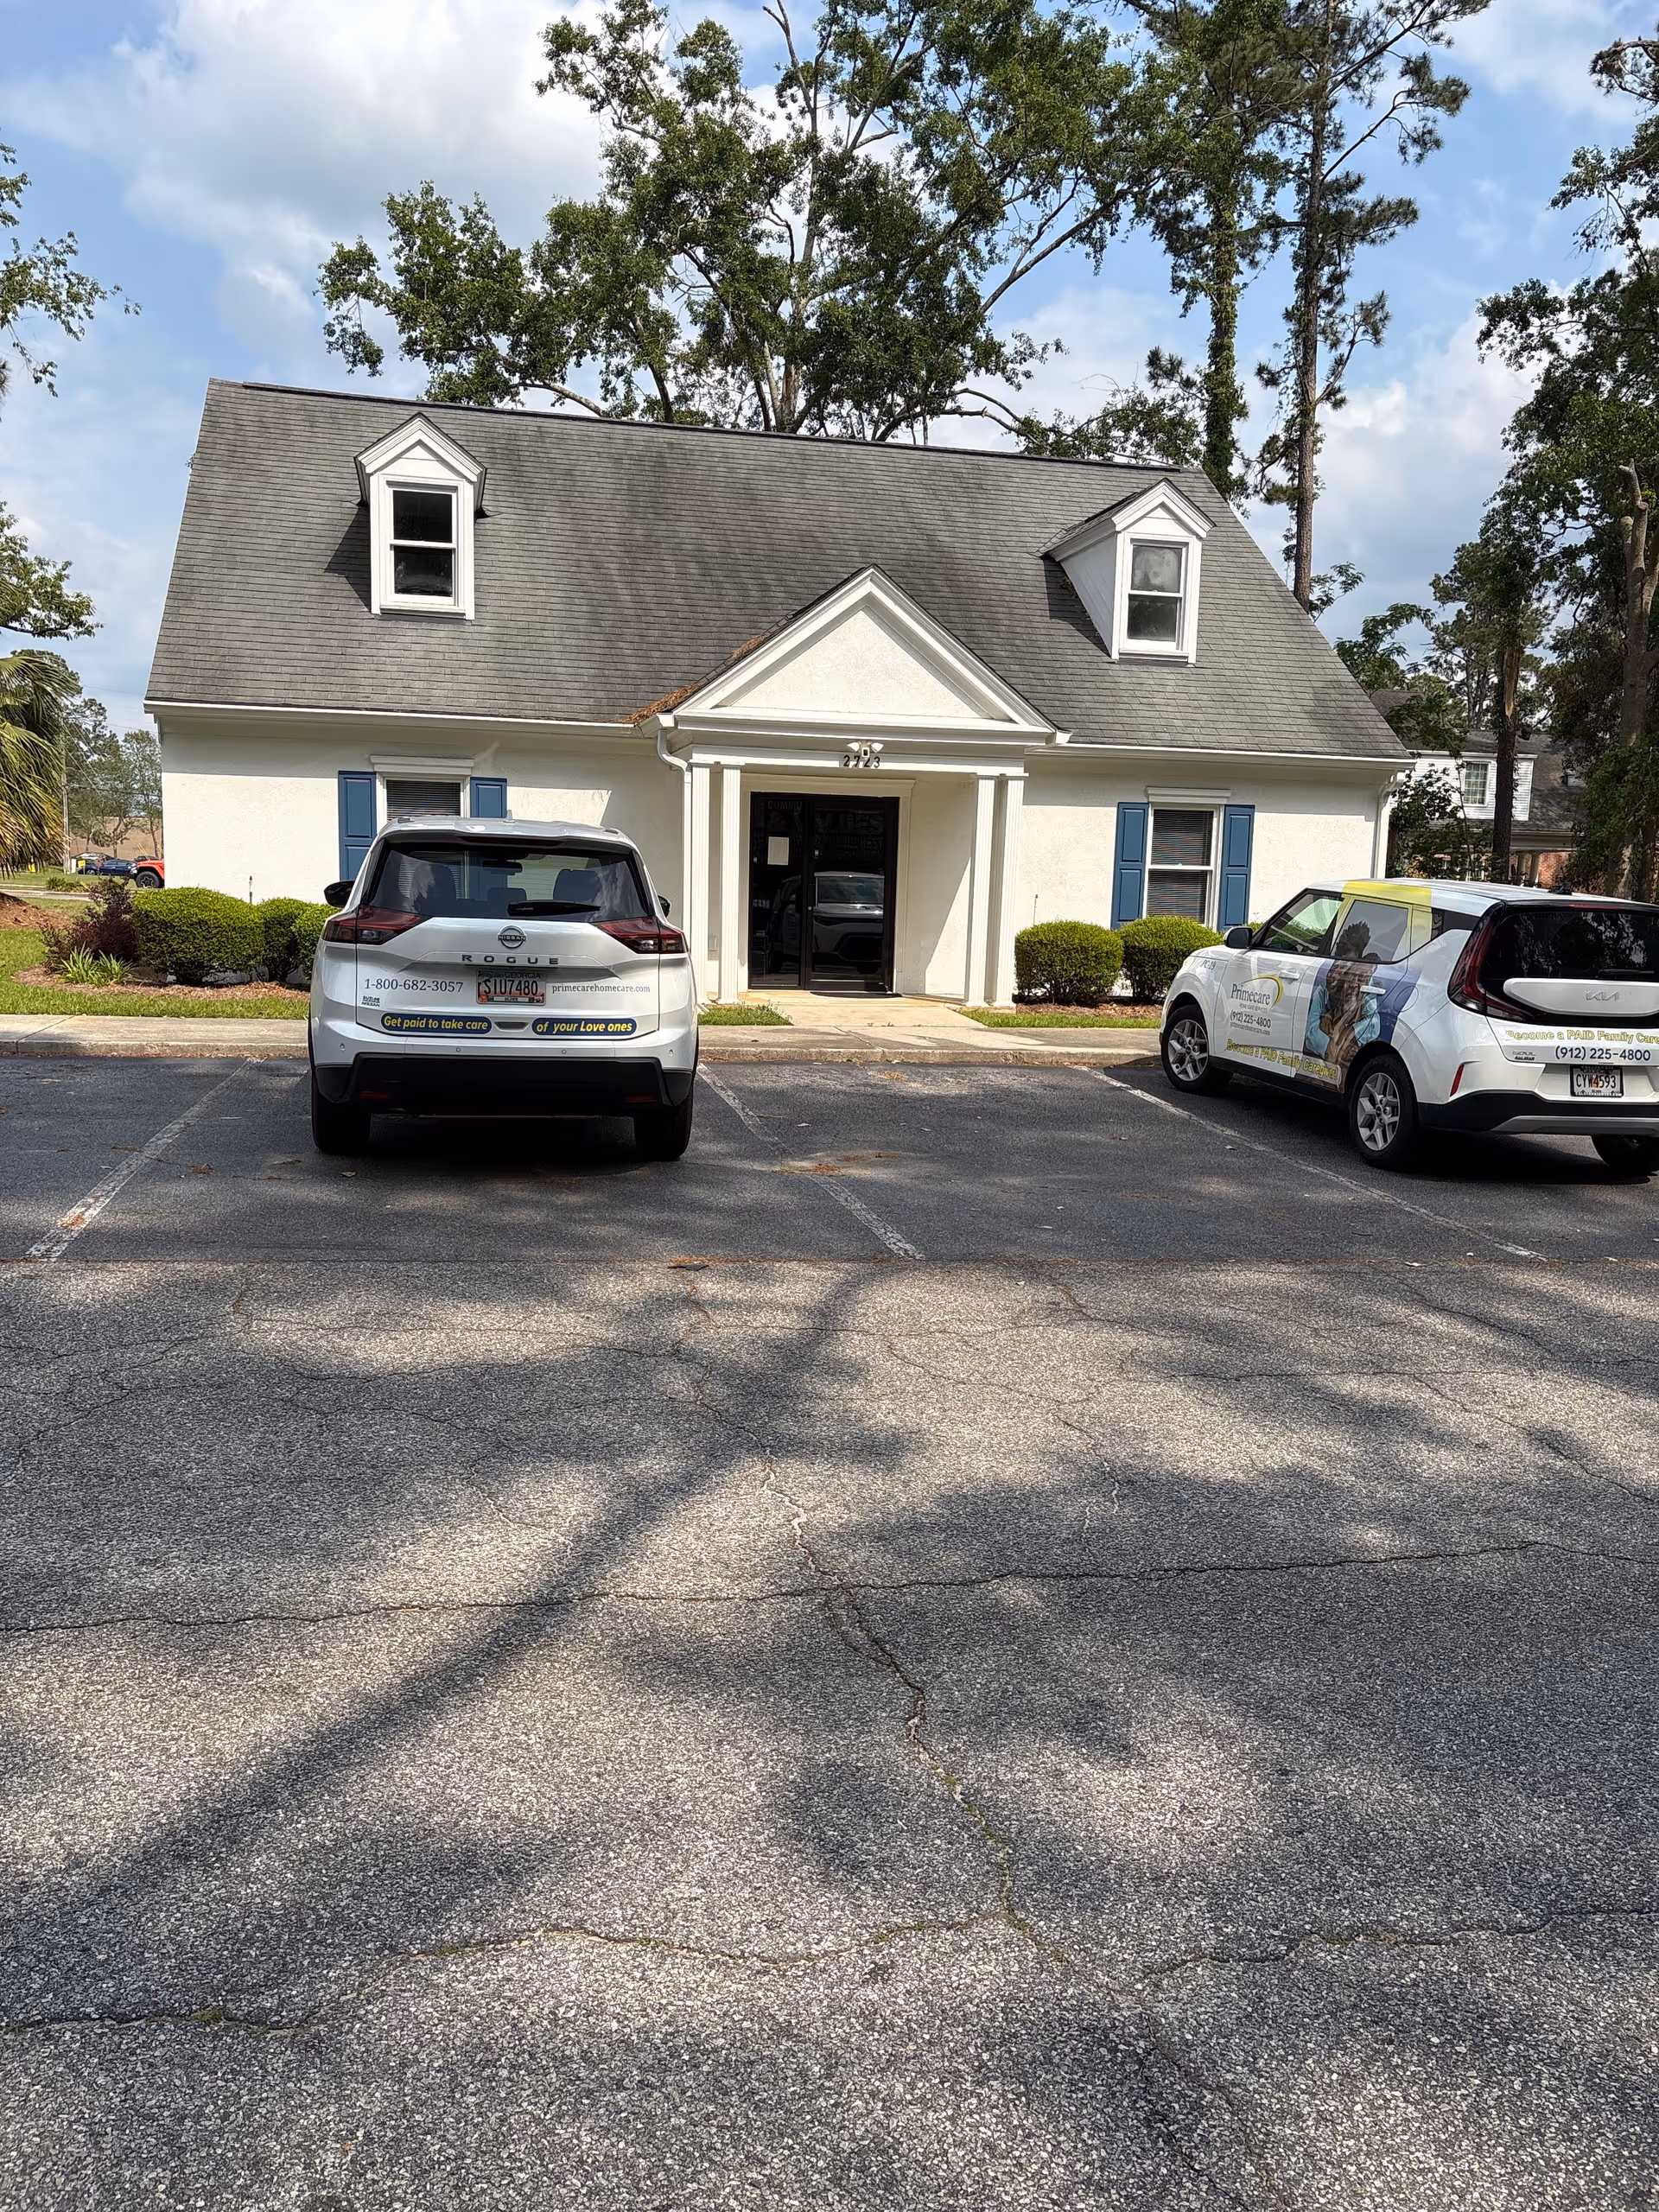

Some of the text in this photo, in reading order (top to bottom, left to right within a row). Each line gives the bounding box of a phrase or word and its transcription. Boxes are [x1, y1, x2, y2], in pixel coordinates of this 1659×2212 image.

[843, 754, 880, 768] 2723
[461, 954, 559, 965] ROGUE
[365, 978, 464, 993] 1-800-682-3057
[483, 979, 538, 996] SIU7480
[552, 983, 651, 995] primecarehomecare.com
[1230, 983, 1271, 1006] Primecare
[385, 1015, 488, 1030] Get paid to take care
[1230, 1009, 1271, 1028] (912) 225-4800
[537, 1020, 632, 1034] of your Love ones
[1506, 1030, 1554, 1040] Become
[1557, 1032, 1565, 1040] a
[1567, 1030, 1595, 1040] PAID
[1598, 1031, 1634, 1044] Family
[1227, 1039, 1254, 1057] Become
[1255, 1047, 1260, 1058] a
[1260, 1046, 1277, 1063] PAID
[1277, 1051, 1303, 1071] Family
[1555, 1046, 1651, 1061] (912) 225-4800
[1576, 1074, 1617, 1089] CYW4593
